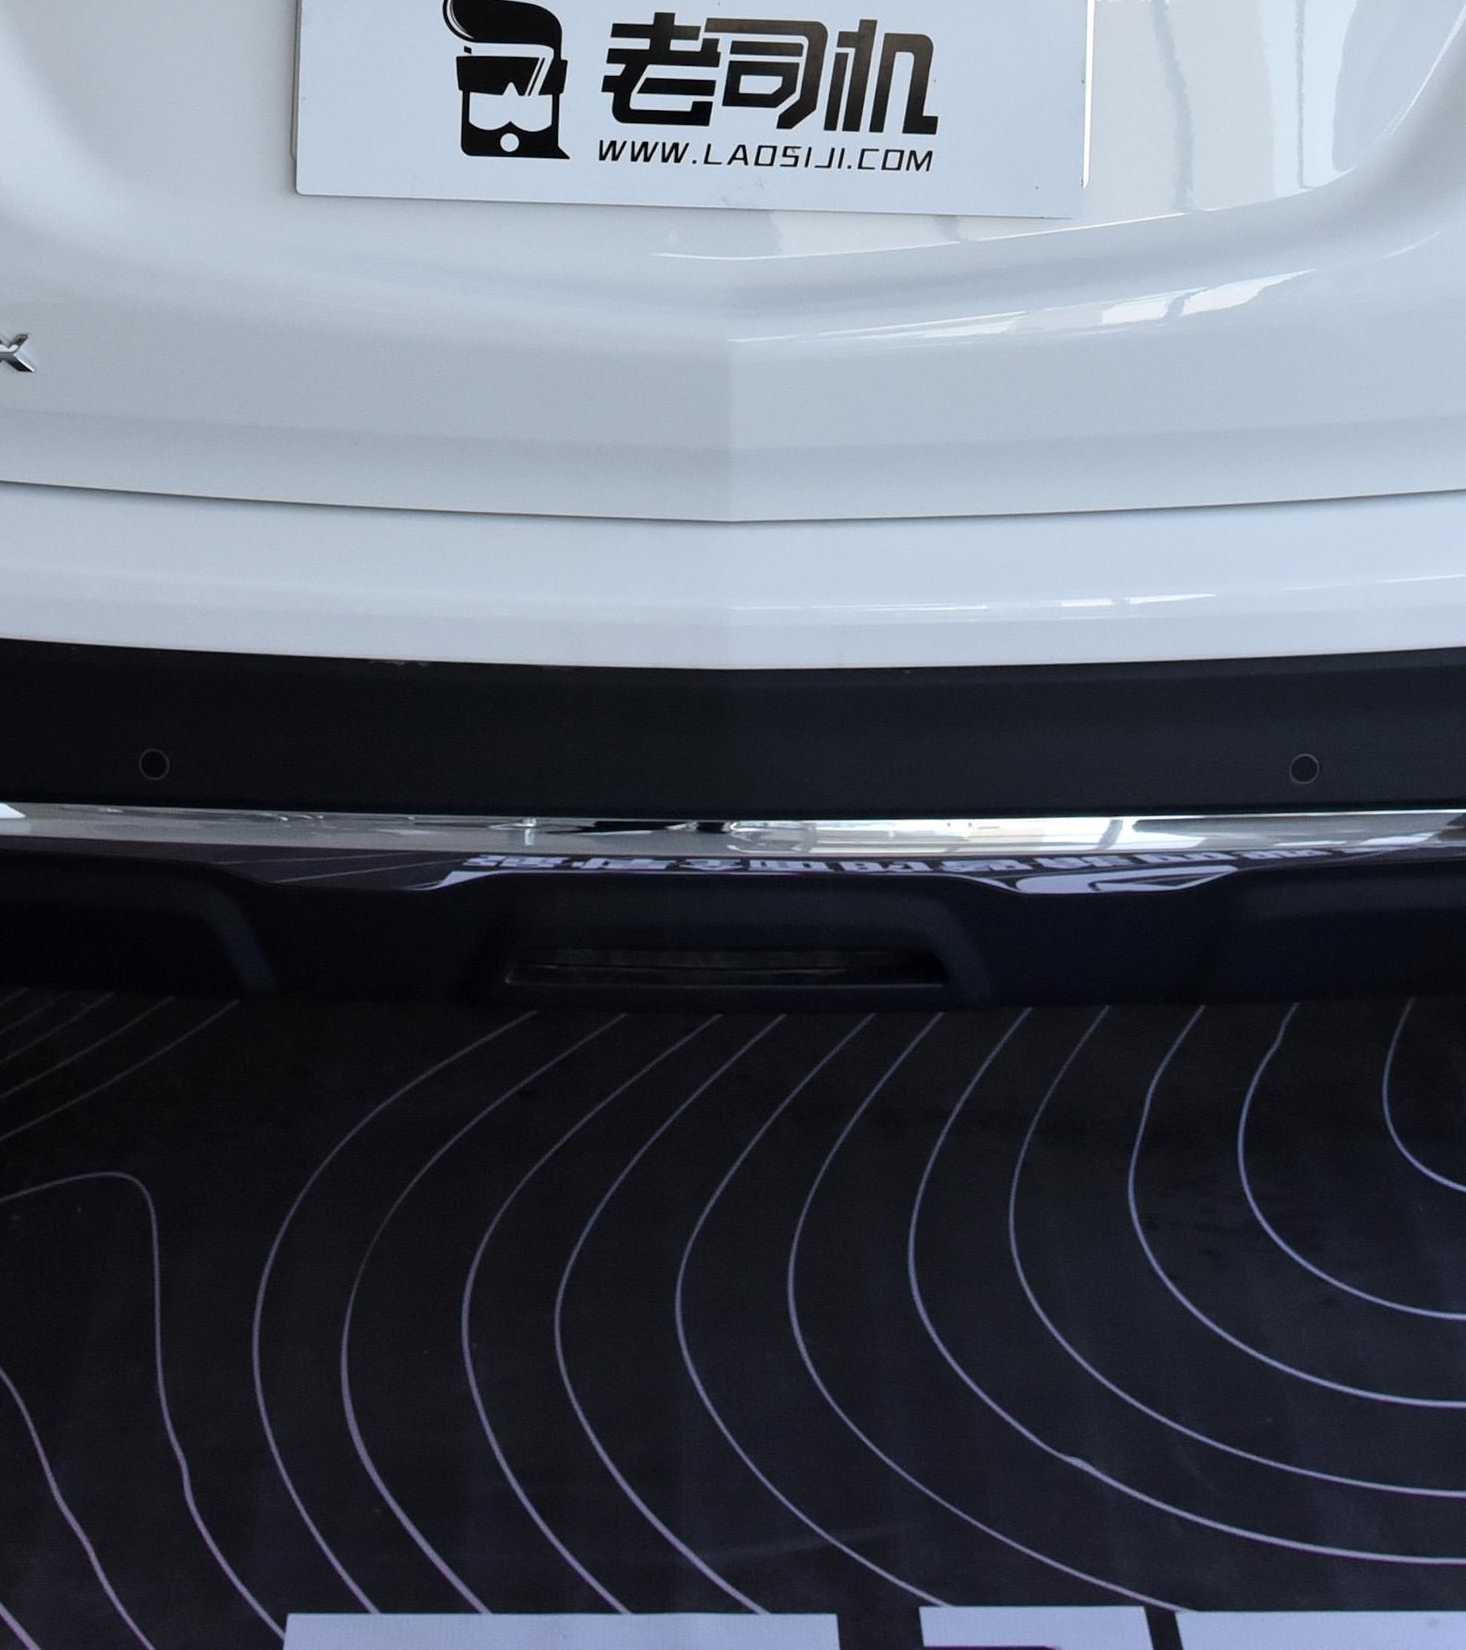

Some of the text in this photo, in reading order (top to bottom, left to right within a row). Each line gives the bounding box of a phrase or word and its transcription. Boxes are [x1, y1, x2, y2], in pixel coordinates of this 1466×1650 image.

[602, 12, 939, 136] 老司机
[598, 139, 934, 173] WWW.LAOSIJI.COM
